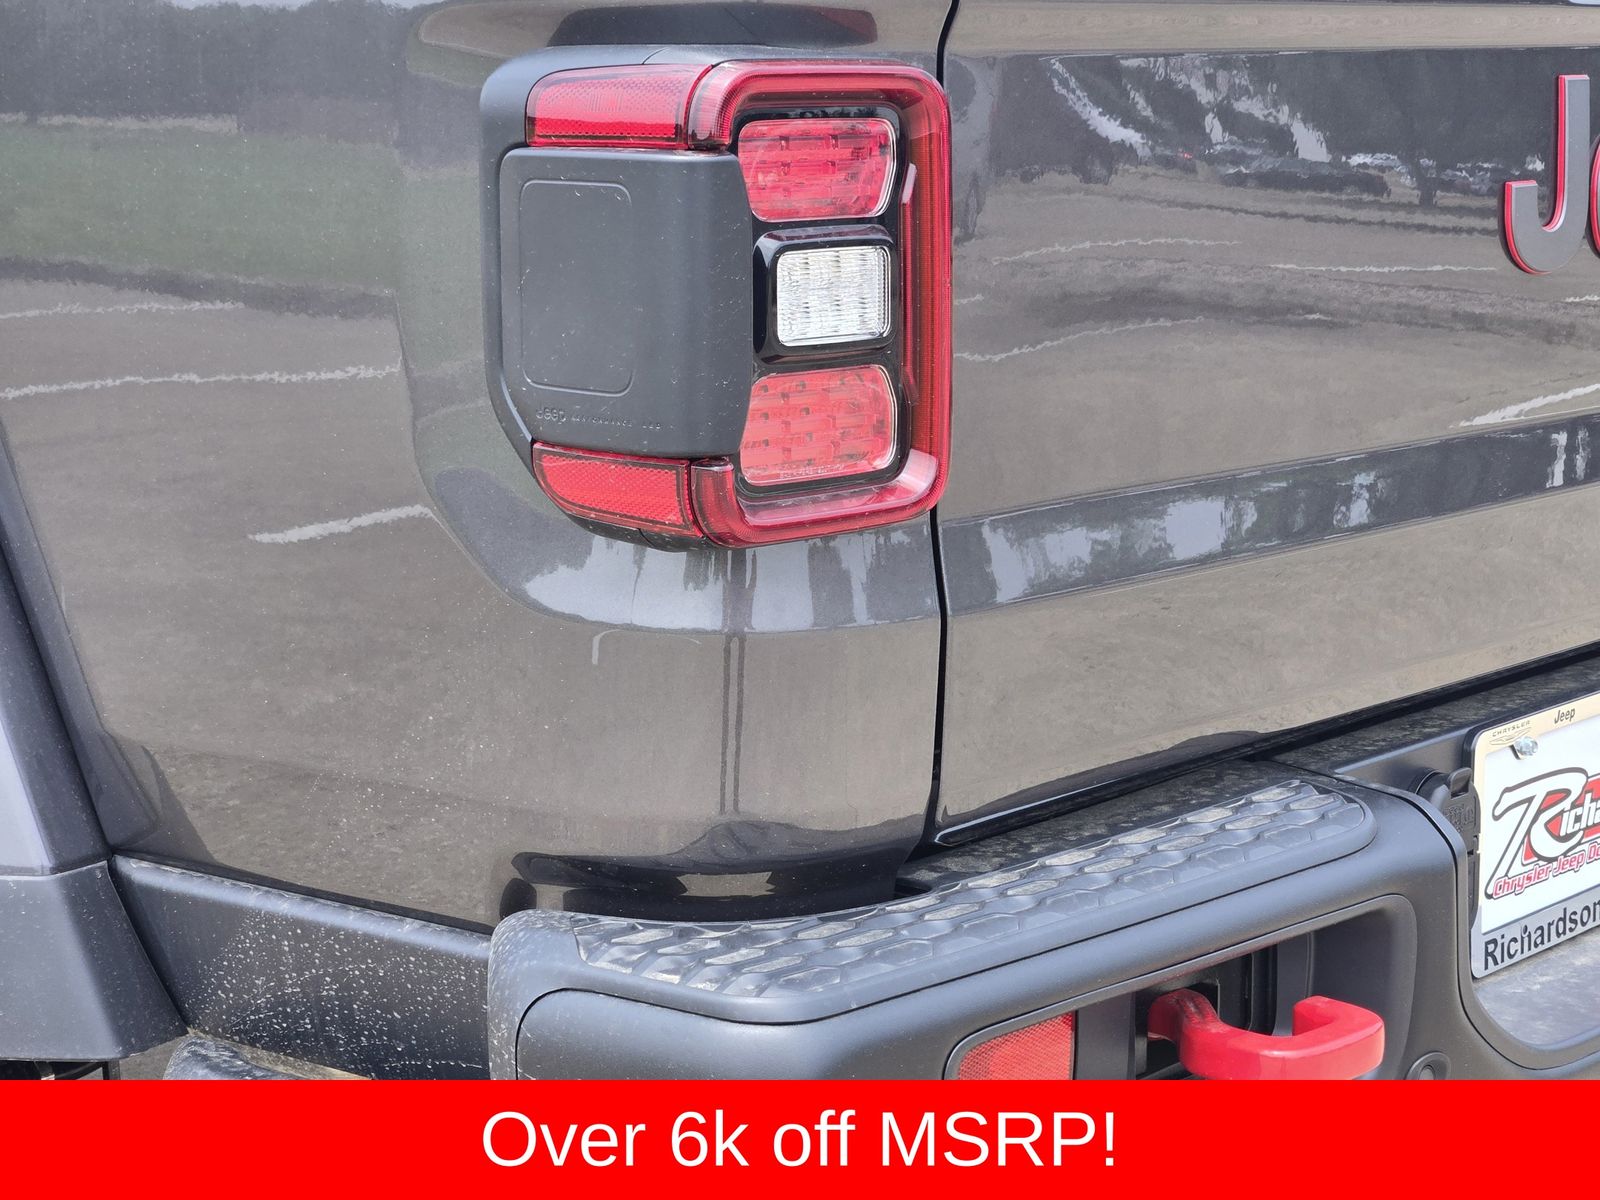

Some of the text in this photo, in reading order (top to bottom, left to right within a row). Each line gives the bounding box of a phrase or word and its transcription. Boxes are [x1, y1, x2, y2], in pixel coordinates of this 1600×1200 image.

[1505, 74, 1600, 274] J
[1492, 720, 1531, 737] CHRYSLER
[1554, 708, 1576, 724] Jeep
[1493, 864, 1552, 899] Chrysler
[1553, 850, 1585, 877] Jeep
